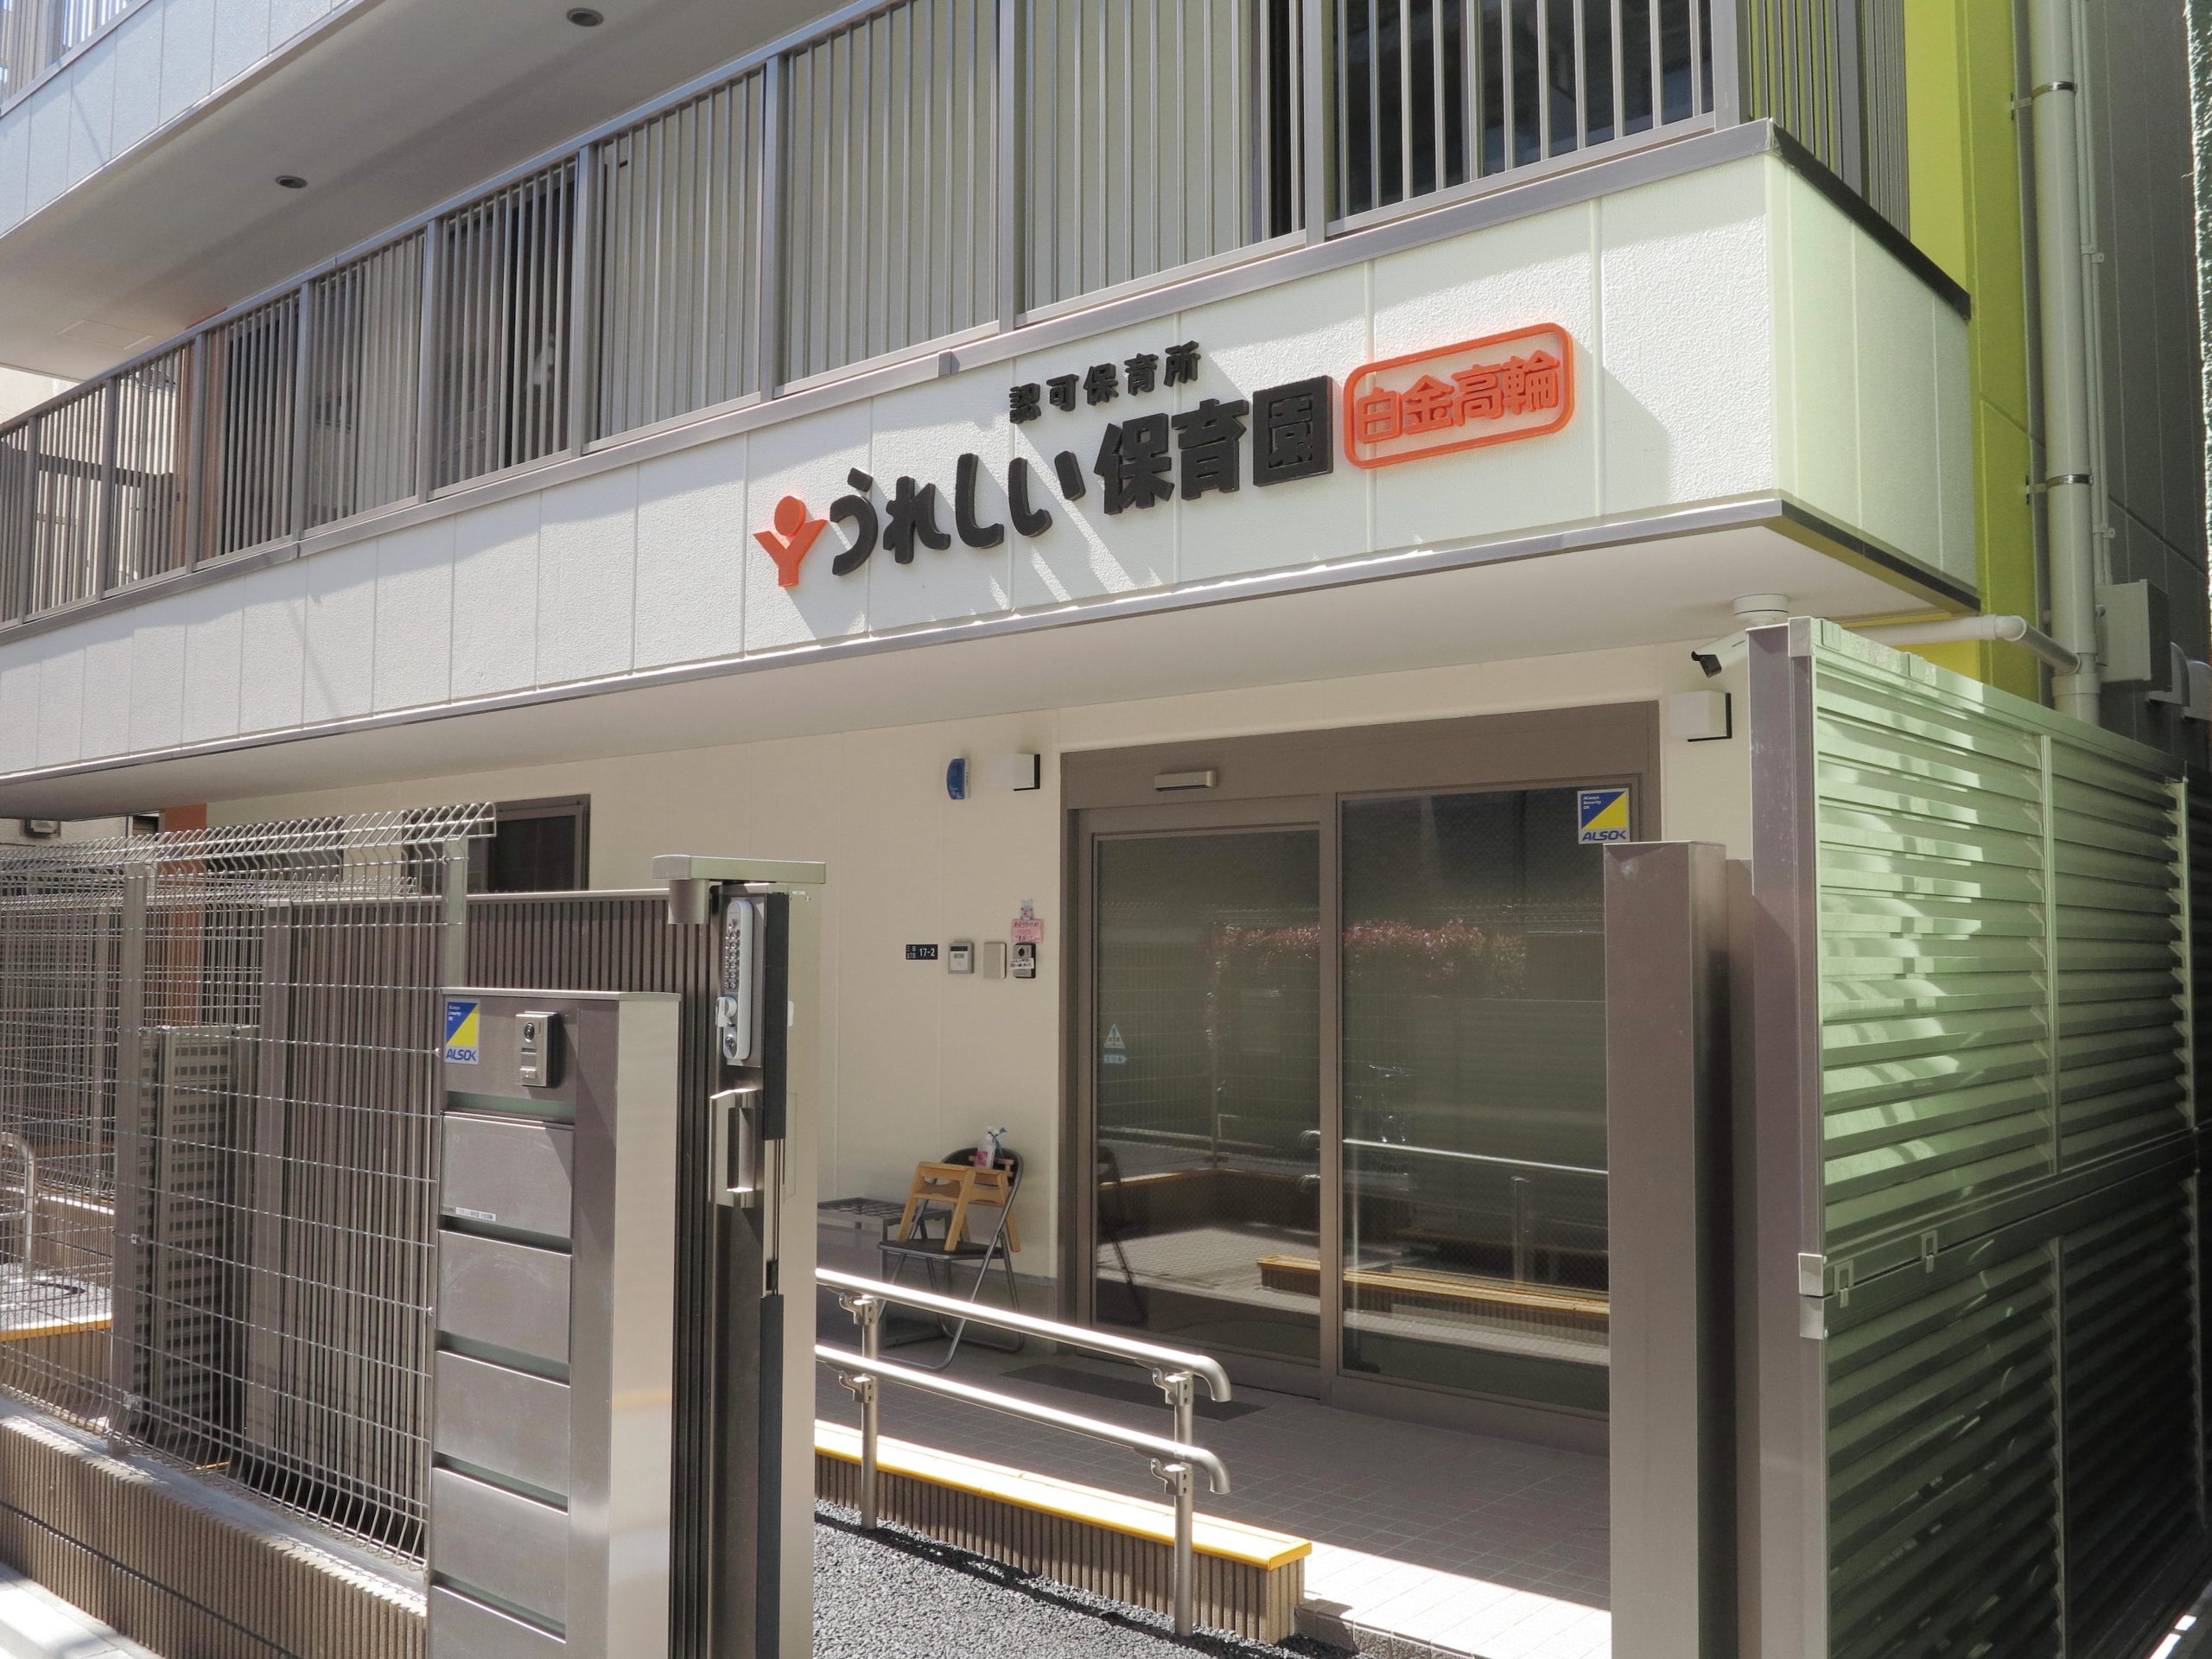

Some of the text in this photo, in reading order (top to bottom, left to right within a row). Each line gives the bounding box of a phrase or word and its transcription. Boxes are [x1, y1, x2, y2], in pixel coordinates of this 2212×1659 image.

[1009, 340, 1201, 424] 認可保育所
[830, 349, 1560, 575] うれしい保育園 白金高輪
[1582, 830, 1626, 841] ALSOK
[919, 948, 935, 957] 17-2
[446, 1049, 476, 1061] ALSOK
